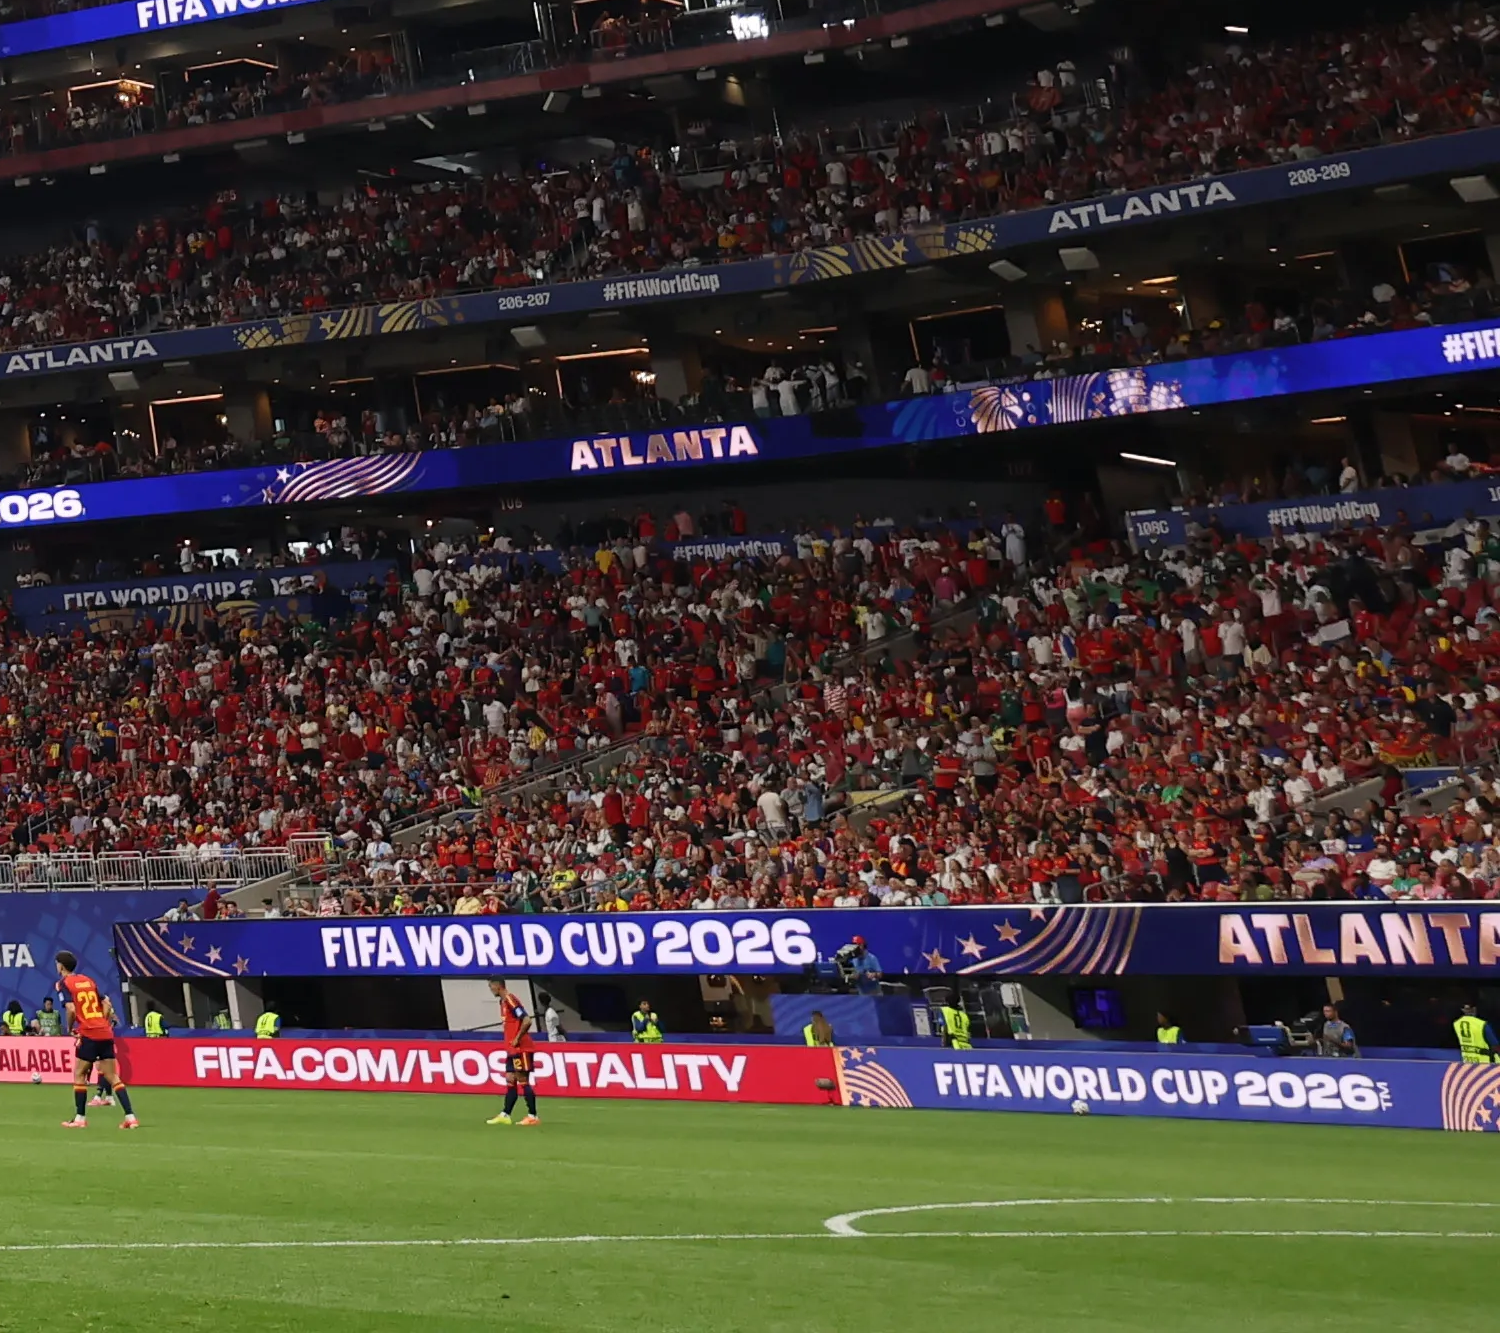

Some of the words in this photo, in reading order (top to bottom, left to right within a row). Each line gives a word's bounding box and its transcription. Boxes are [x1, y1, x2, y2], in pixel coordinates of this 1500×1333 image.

[1288, 162, 1351, 186] 208-209
[1048, 181, 1236, 234] ATLANTA
[498, 292, 550, 310] 206-207
[603, 272, 720, 301] #FIFAWorldCup
[5, 338, 157, 374] ATLANTA
[570, 425, 758, 471] ATLANTA
[321, 926, 402, 968] FIFA
[403, 922, 554, 967] WORLD
[559, 922, 646, 966] CUP
[652, 919, 816, 966] 2026
[77, 991, 104, 1019] 22
[193, 1046, 746, 1092] FIFA.COM/HOSPITALITY
[933, 1063, 1010, 1099] FIFA
[1011, 1065, 1147, 1102] WORLD
[1153, 1069, 1228, 1105] CUP
[1237, 1071, 1377, 1110] 2026
